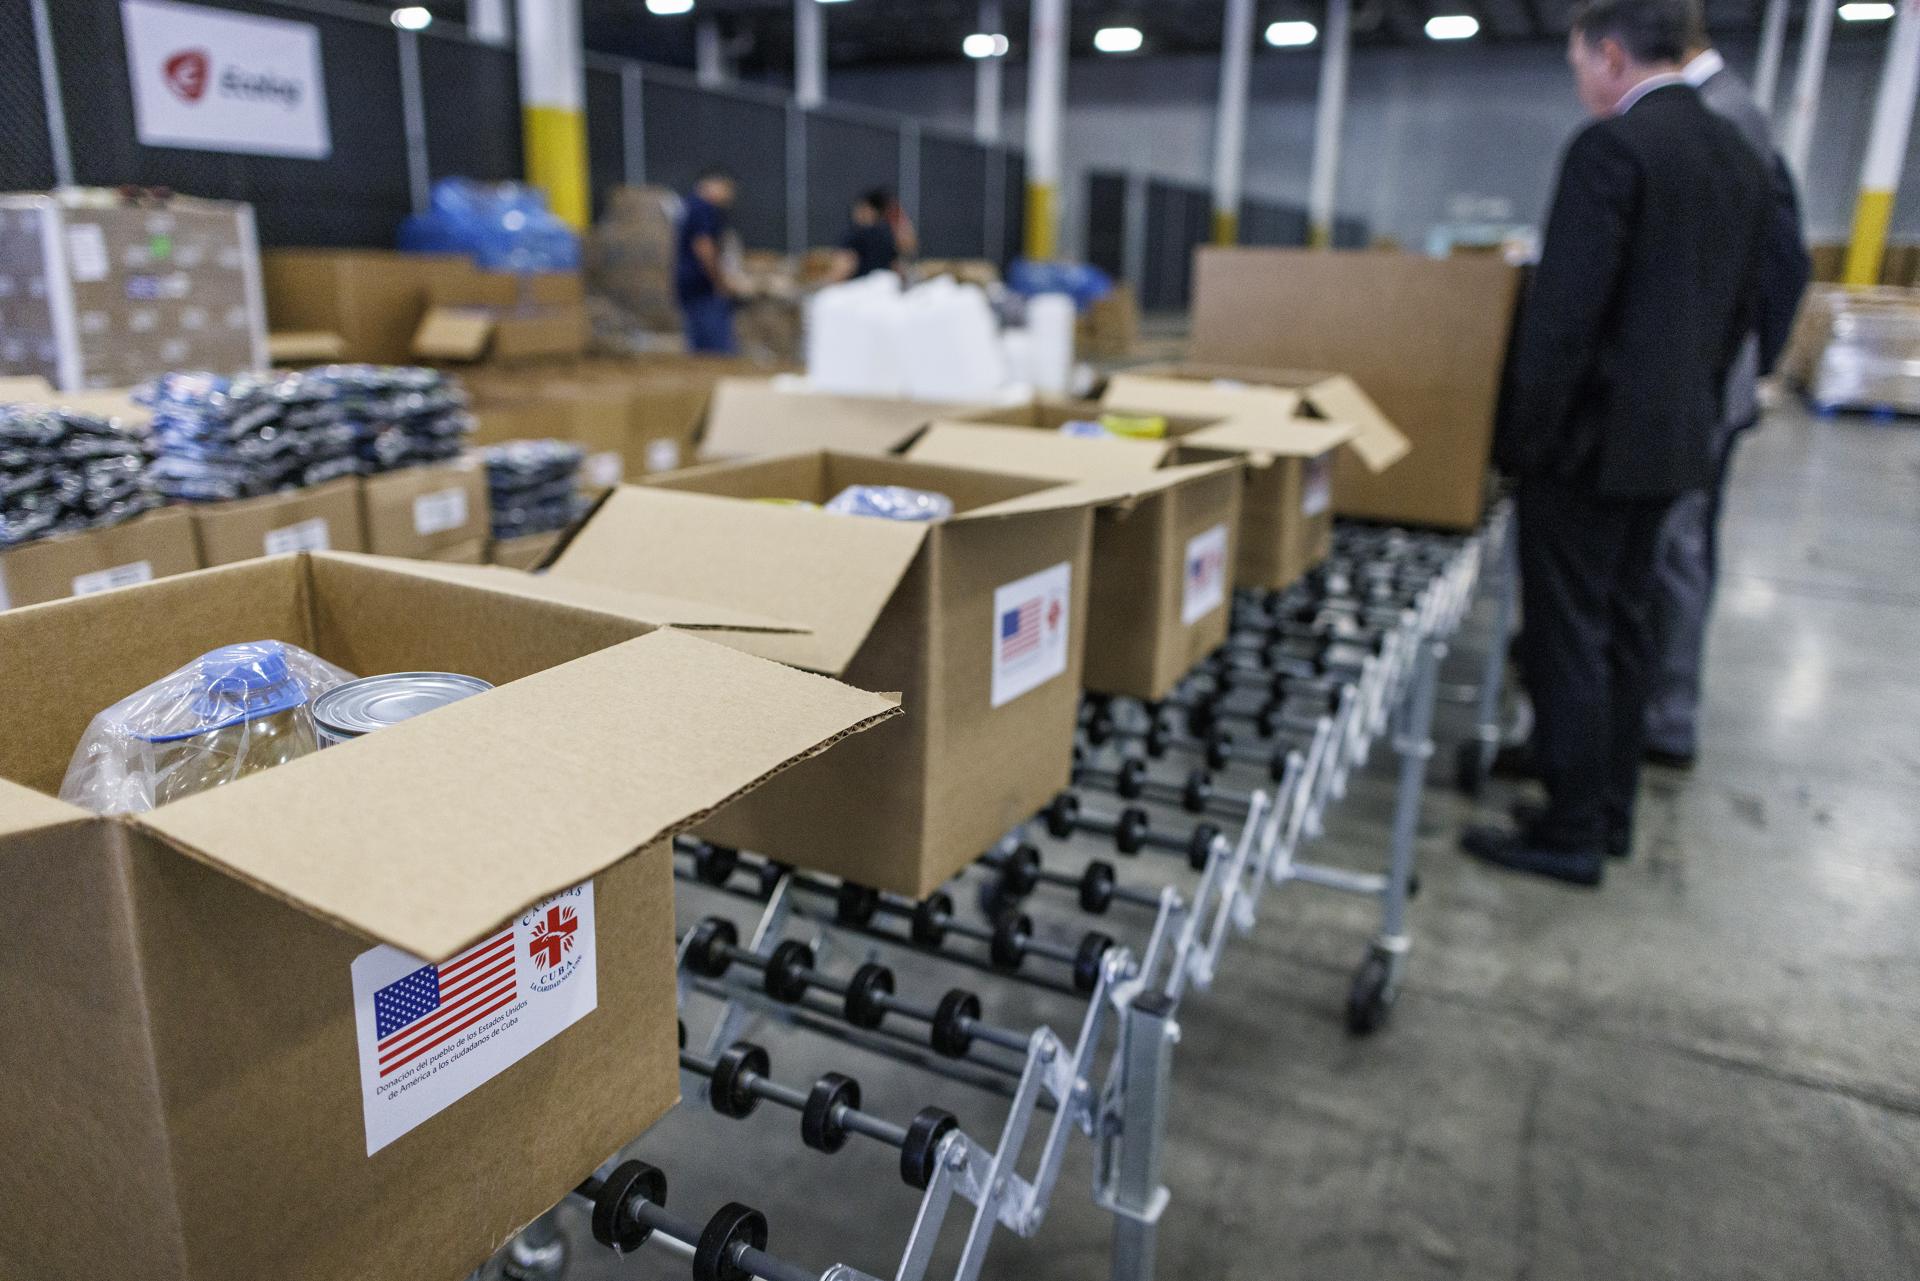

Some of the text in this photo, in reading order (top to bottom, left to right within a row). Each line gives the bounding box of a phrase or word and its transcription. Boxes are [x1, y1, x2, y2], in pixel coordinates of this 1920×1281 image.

[530, 982, 537, 992] LA
[537, 978, 561, 993] CARIDAD
[540, 960, 573, 985] CUBA
[376, 999, 528, 1096] Donación del pueblo de los Estados Unidos
[388, 1090, 399, 1101] de
[438, 1059, 449, 1070] los
[450, 1034, 490, 1063] ciudadanos
[491, 1028, 500, 1038] de
[500, 1017, 519, 1032] Cuba
